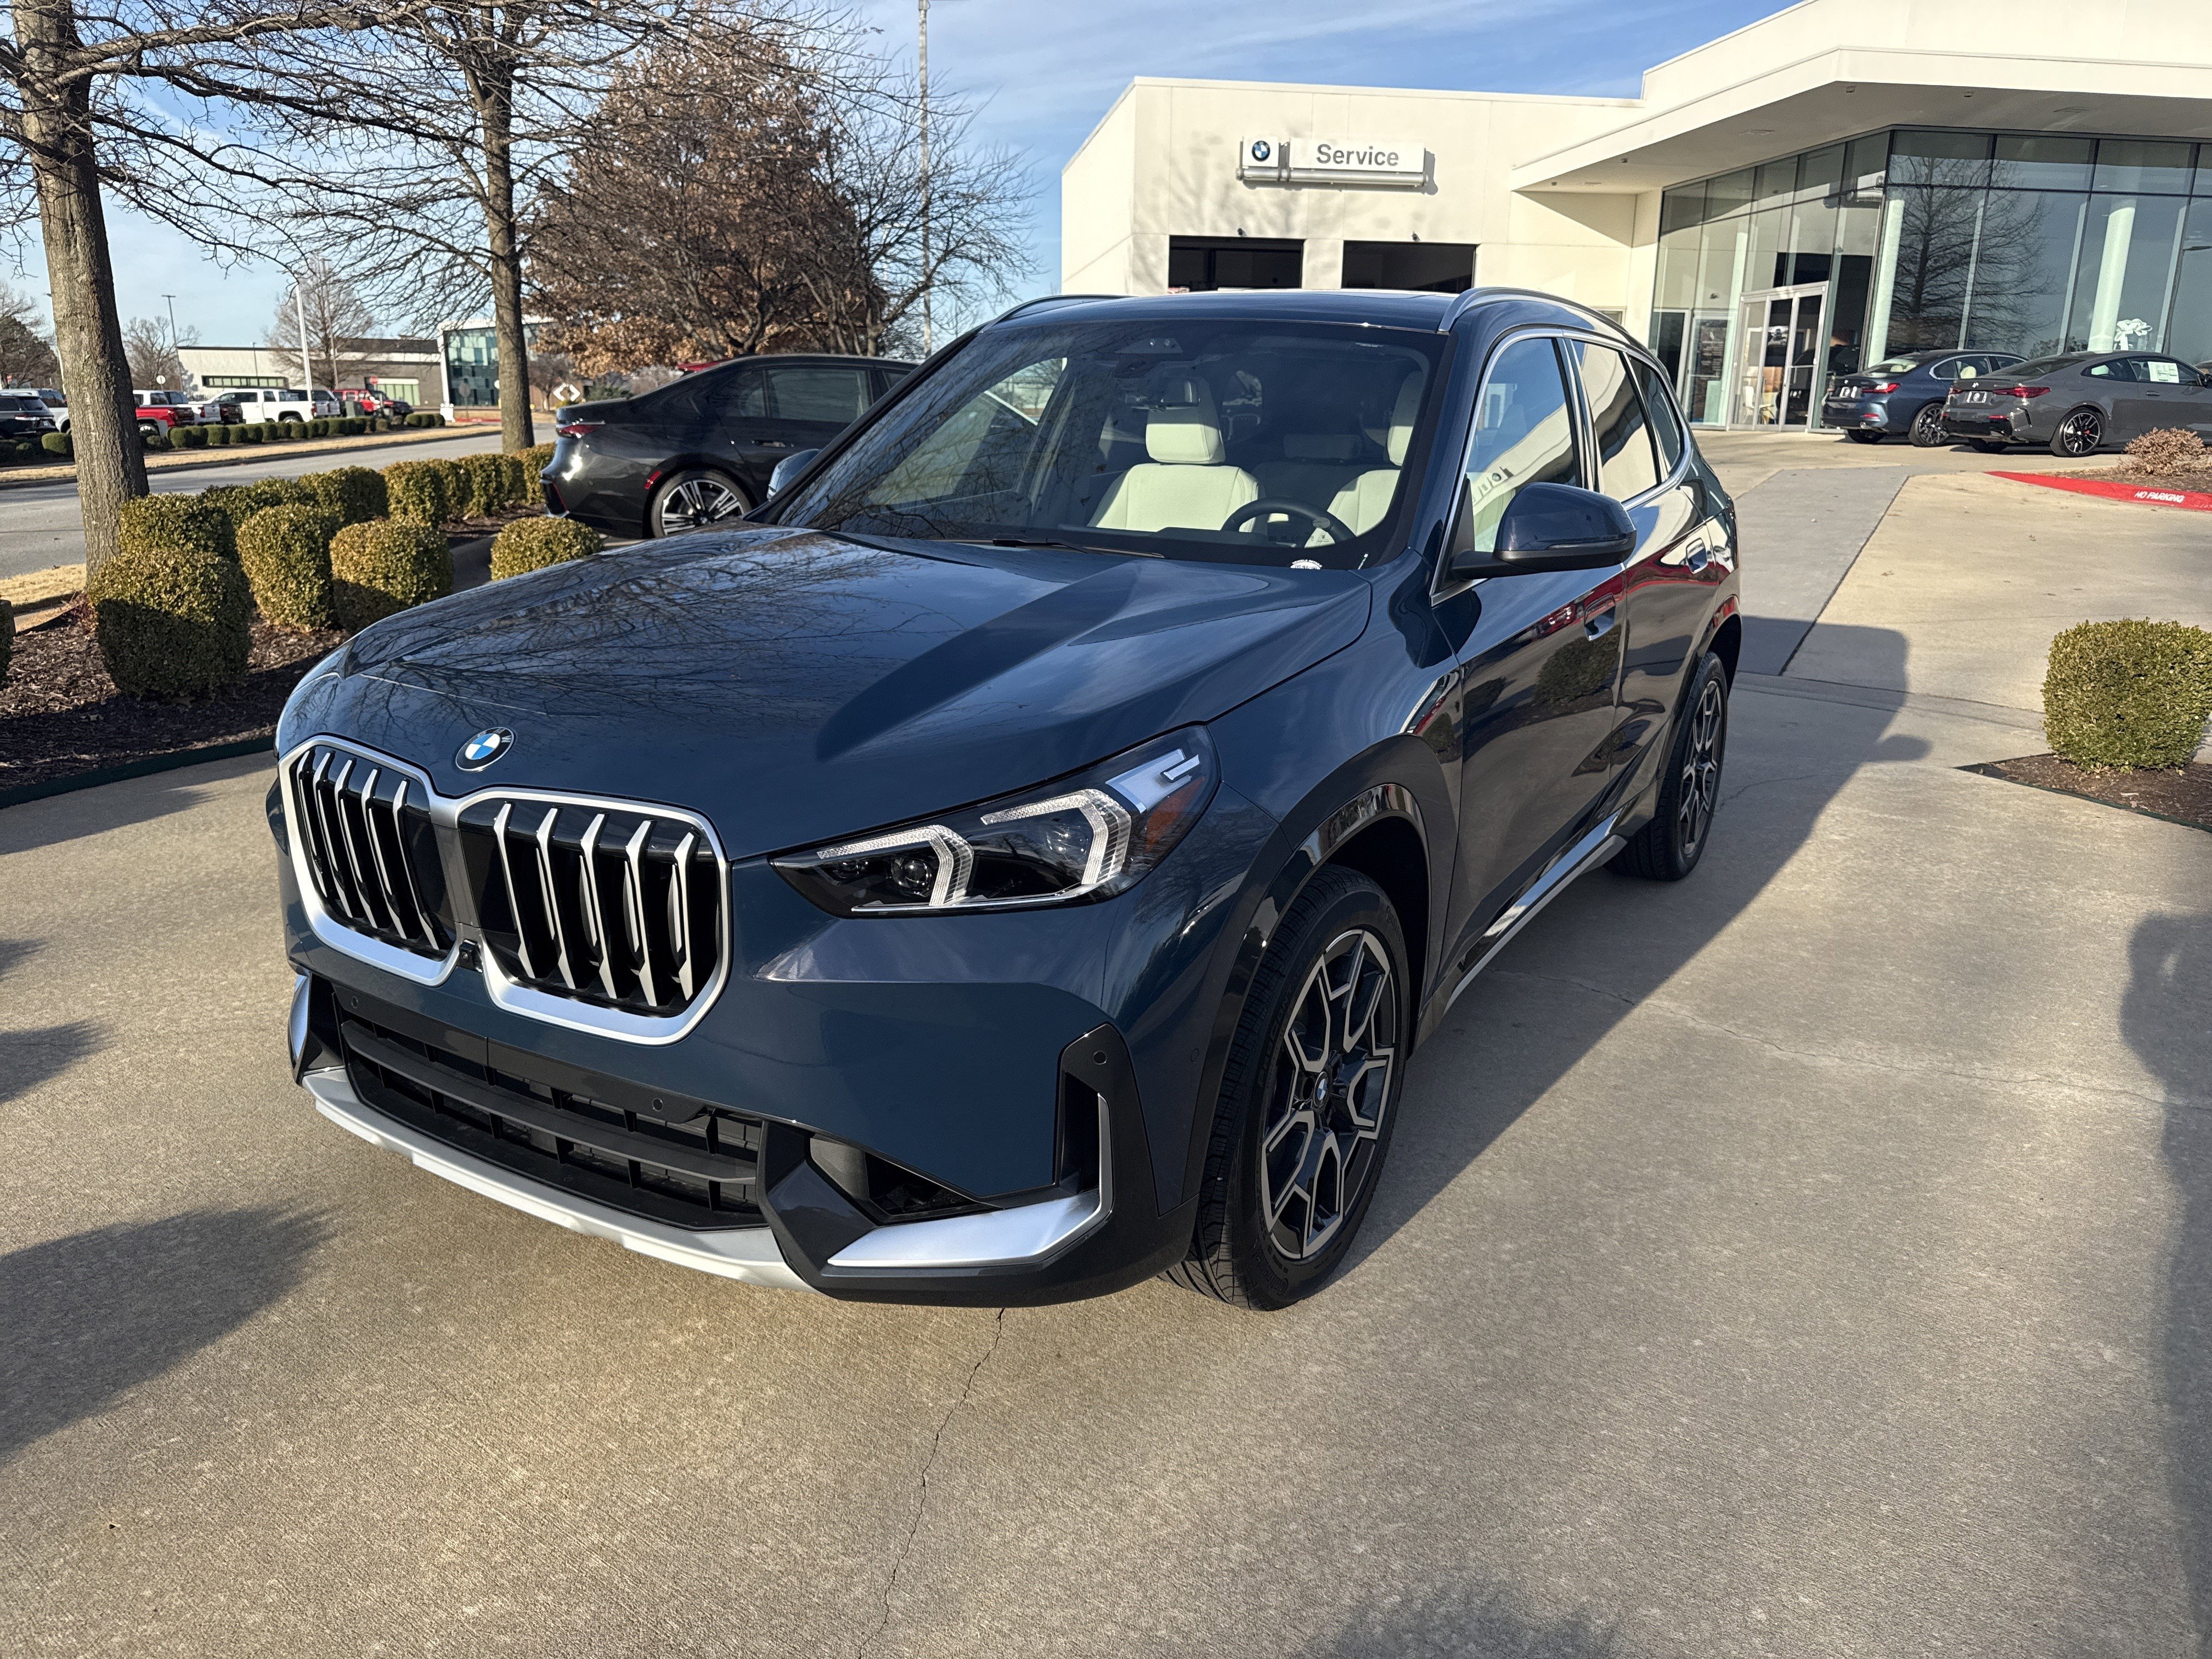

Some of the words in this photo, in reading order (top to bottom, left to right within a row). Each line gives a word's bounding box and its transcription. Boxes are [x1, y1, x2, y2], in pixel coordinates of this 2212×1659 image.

[1317, 144, 1399, 166] Service
[2134, 490, 2148, 499] NO
[2146, 492, 2185, 503] PARKING
